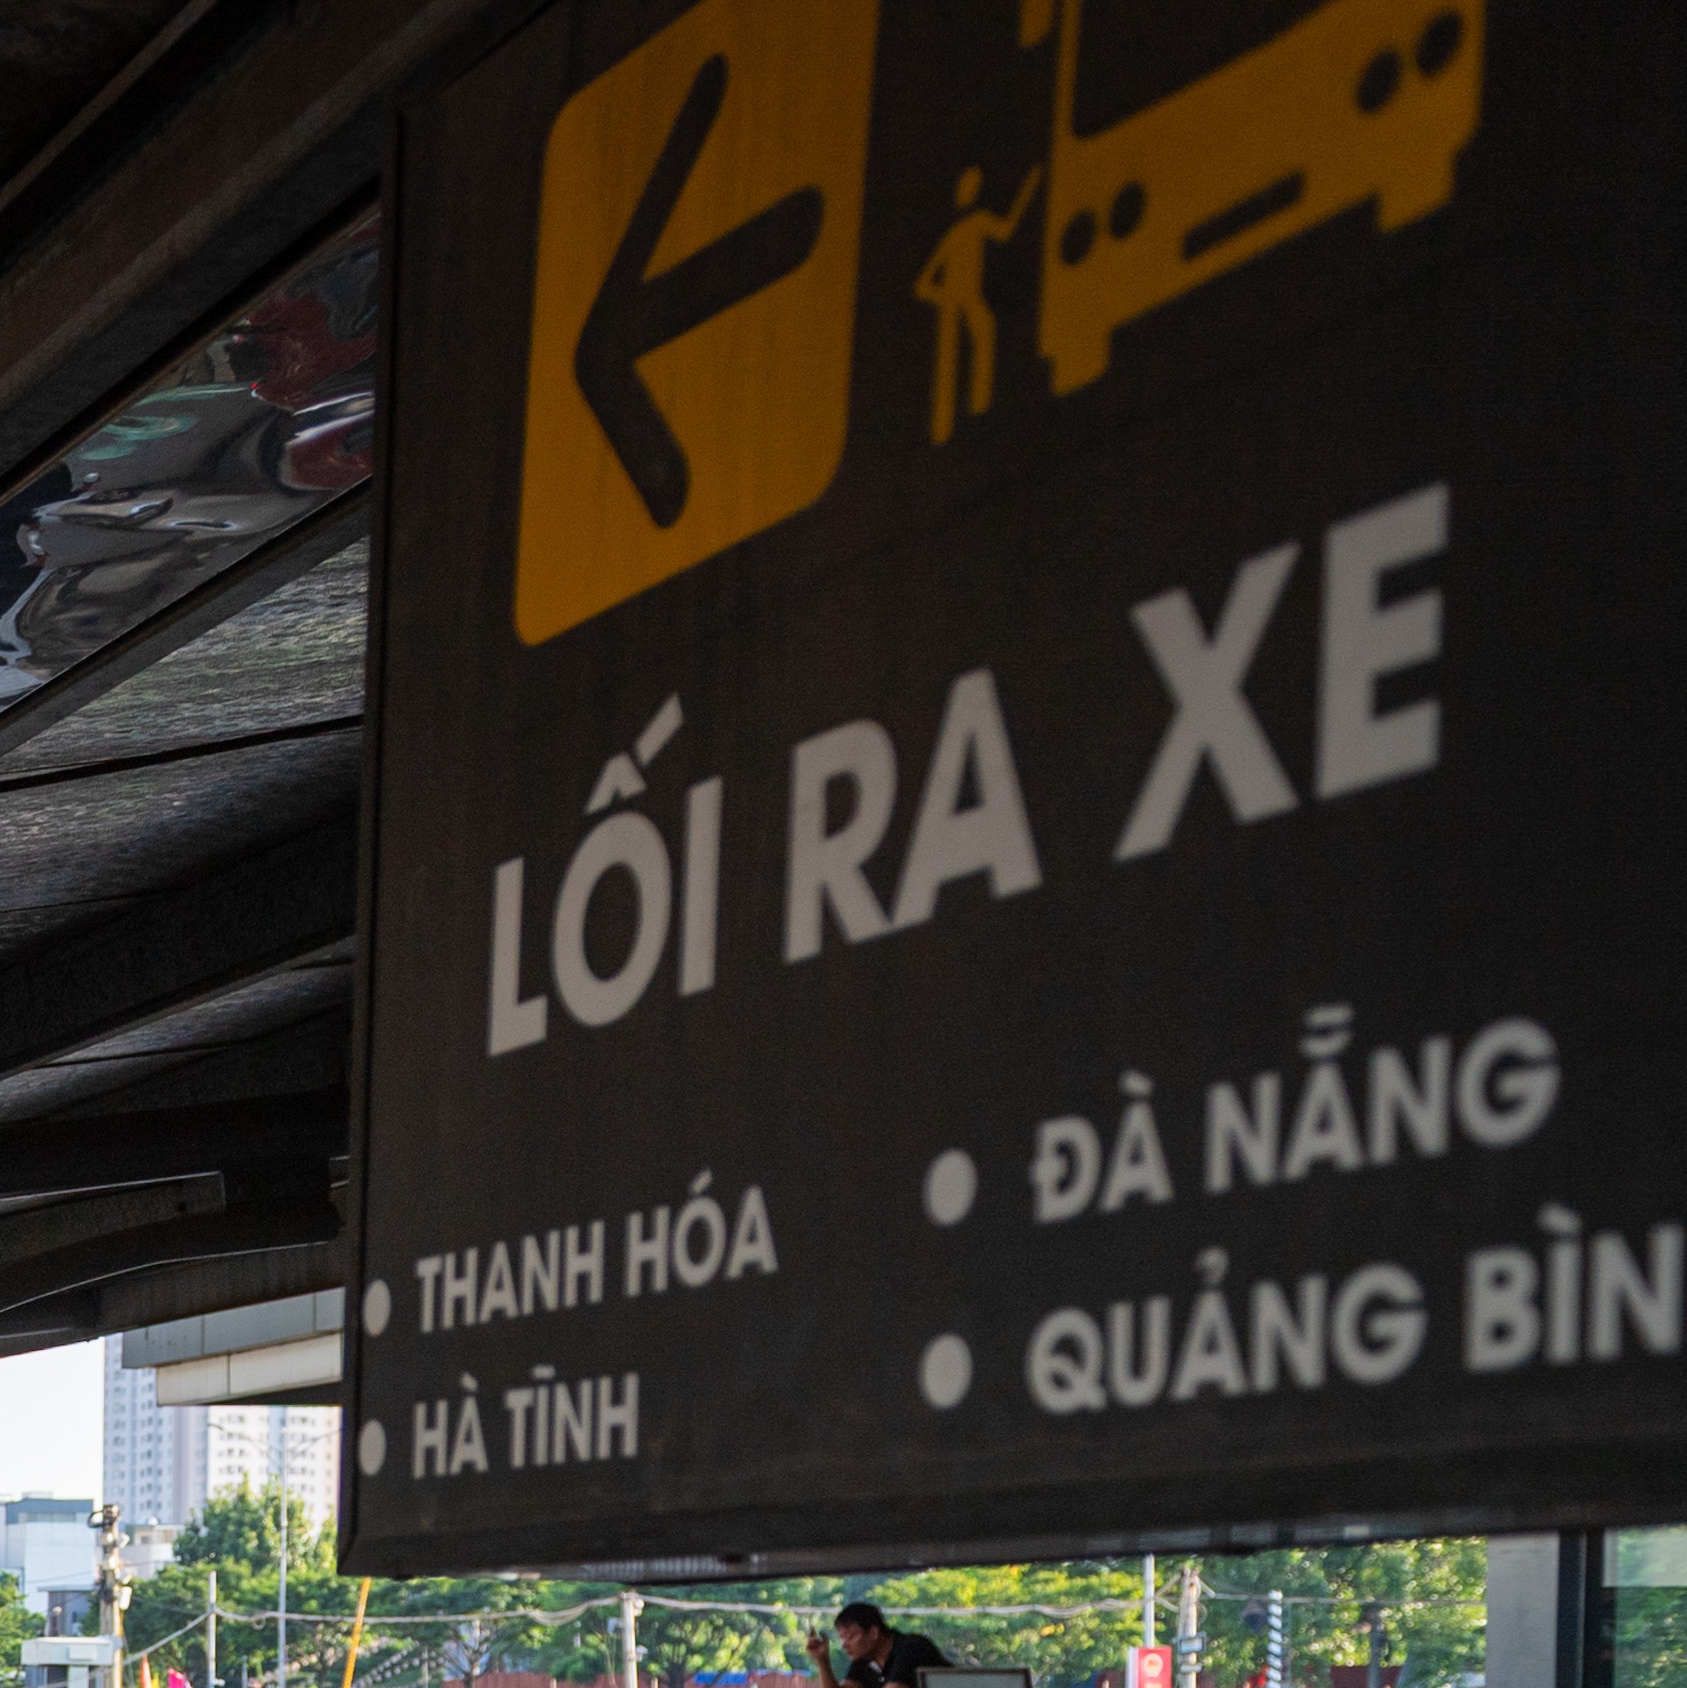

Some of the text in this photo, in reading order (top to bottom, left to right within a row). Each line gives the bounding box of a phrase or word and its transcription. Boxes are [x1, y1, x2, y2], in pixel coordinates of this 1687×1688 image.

[488, 482, 1450, 1058] LỐI RA XE
[1031, 1003, 1563, 1223] ĐÀ NẴNG
[416, 1168, 779, 1334] THANH HÓA
[1029, 1247, 1426, 1413] QUẢNG
[413, 1365, 639, 1479] HÀ TĨNH
